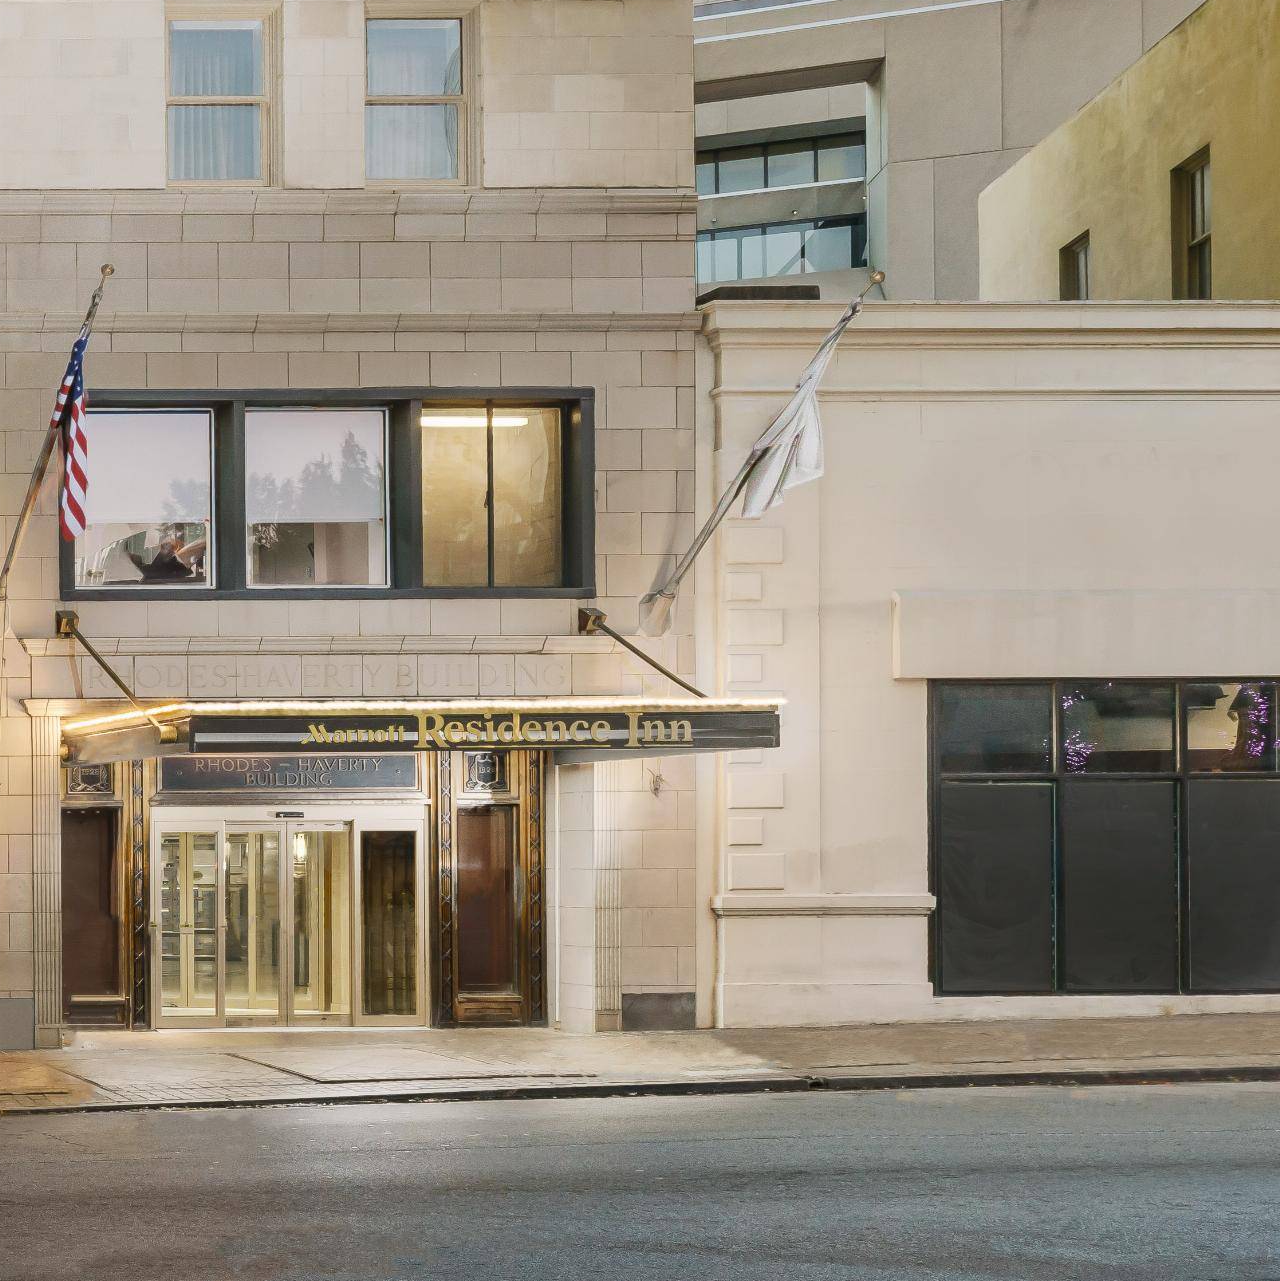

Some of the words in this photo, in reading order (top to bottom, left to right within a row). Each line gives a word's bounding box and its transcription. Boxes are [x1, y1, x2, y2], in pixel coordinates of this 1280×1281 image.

[395, 663, 566, 688] BUILDING
[301, 723, 406, 744] Marriott
[413, 711, 611, 749] Residence
[624, 712, 693, 747] Inn
[195, 758, 272, 772] RHODES
[297, 758, 384, 772] HAVERTY
[244, 772, 332, 787] BUILDING
